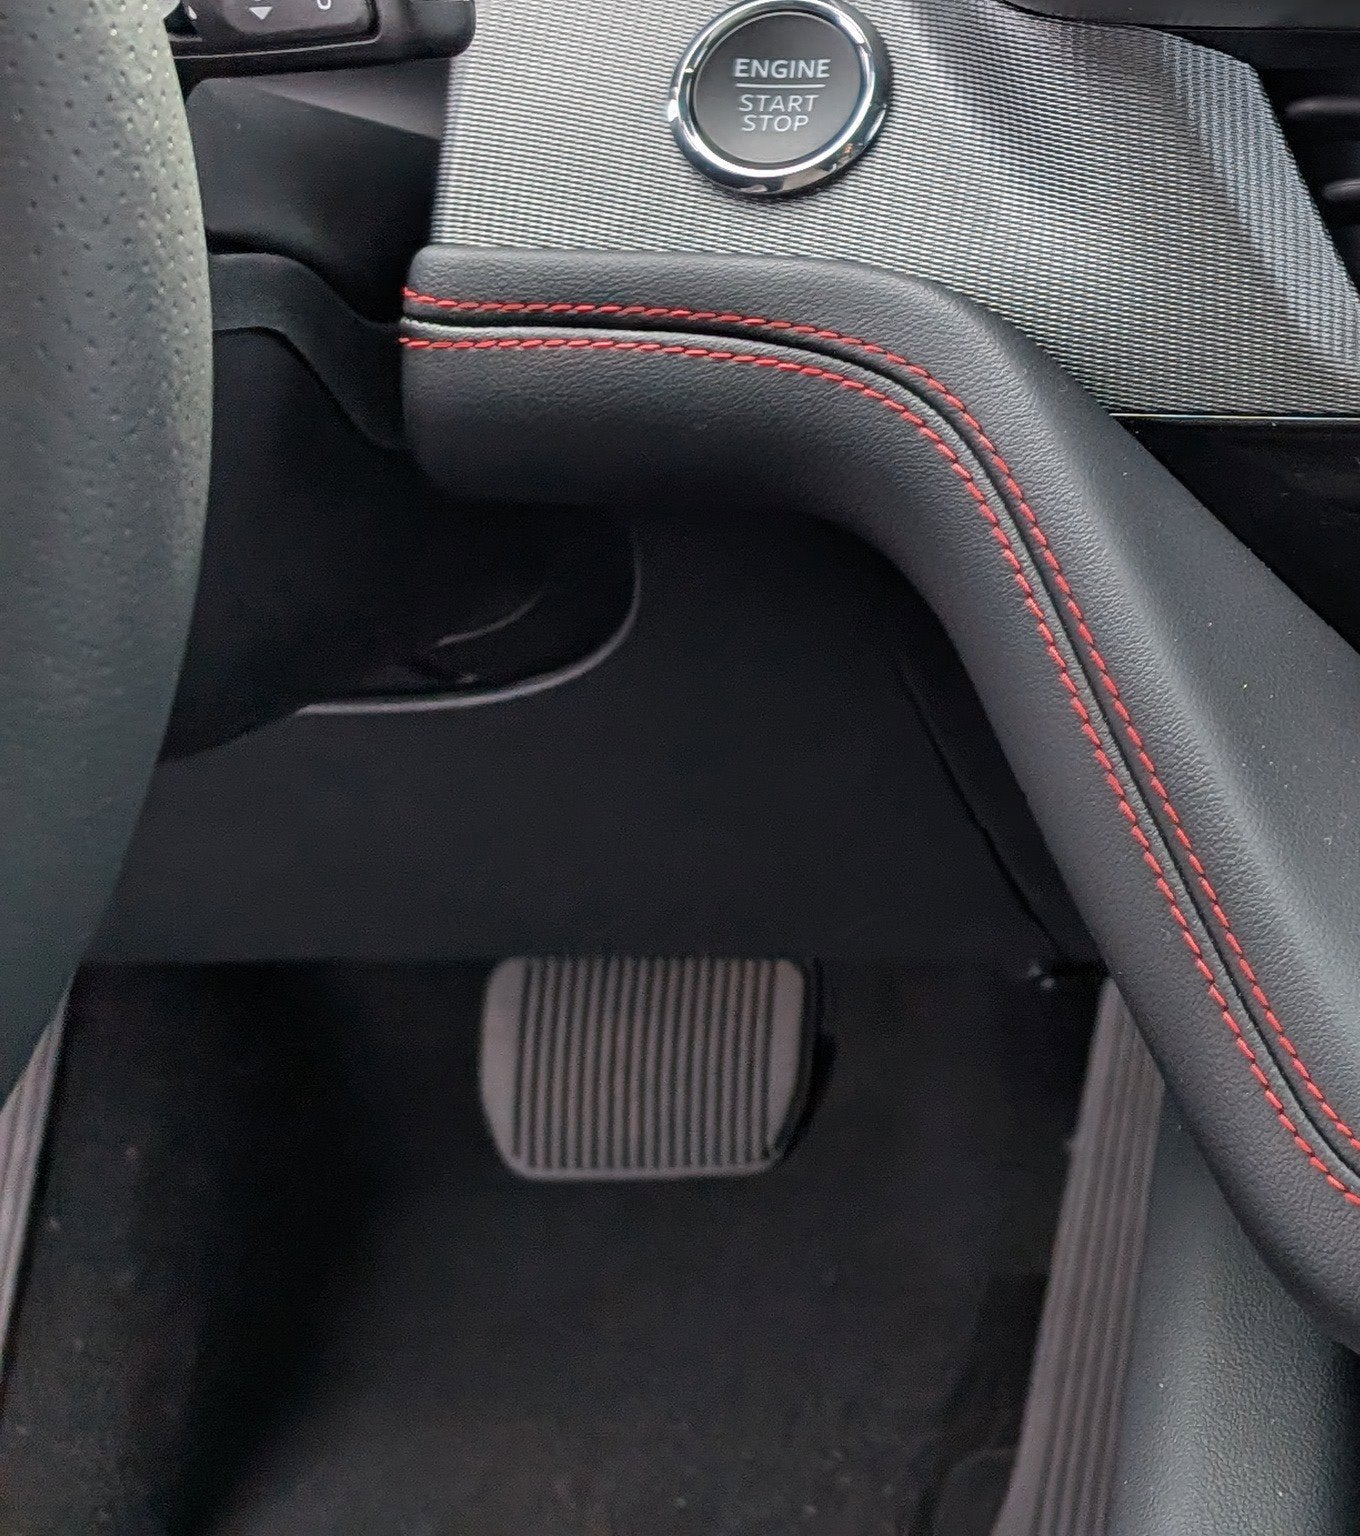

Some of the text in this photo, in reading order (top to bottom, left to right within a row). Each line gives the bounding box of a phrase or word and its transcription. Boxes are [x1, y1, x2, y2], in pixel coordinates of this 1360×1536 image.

[732, 58, 832, 79] ENGINE
[738, 94, 820, 113] START
[741, 115, 810, 133] STOP
